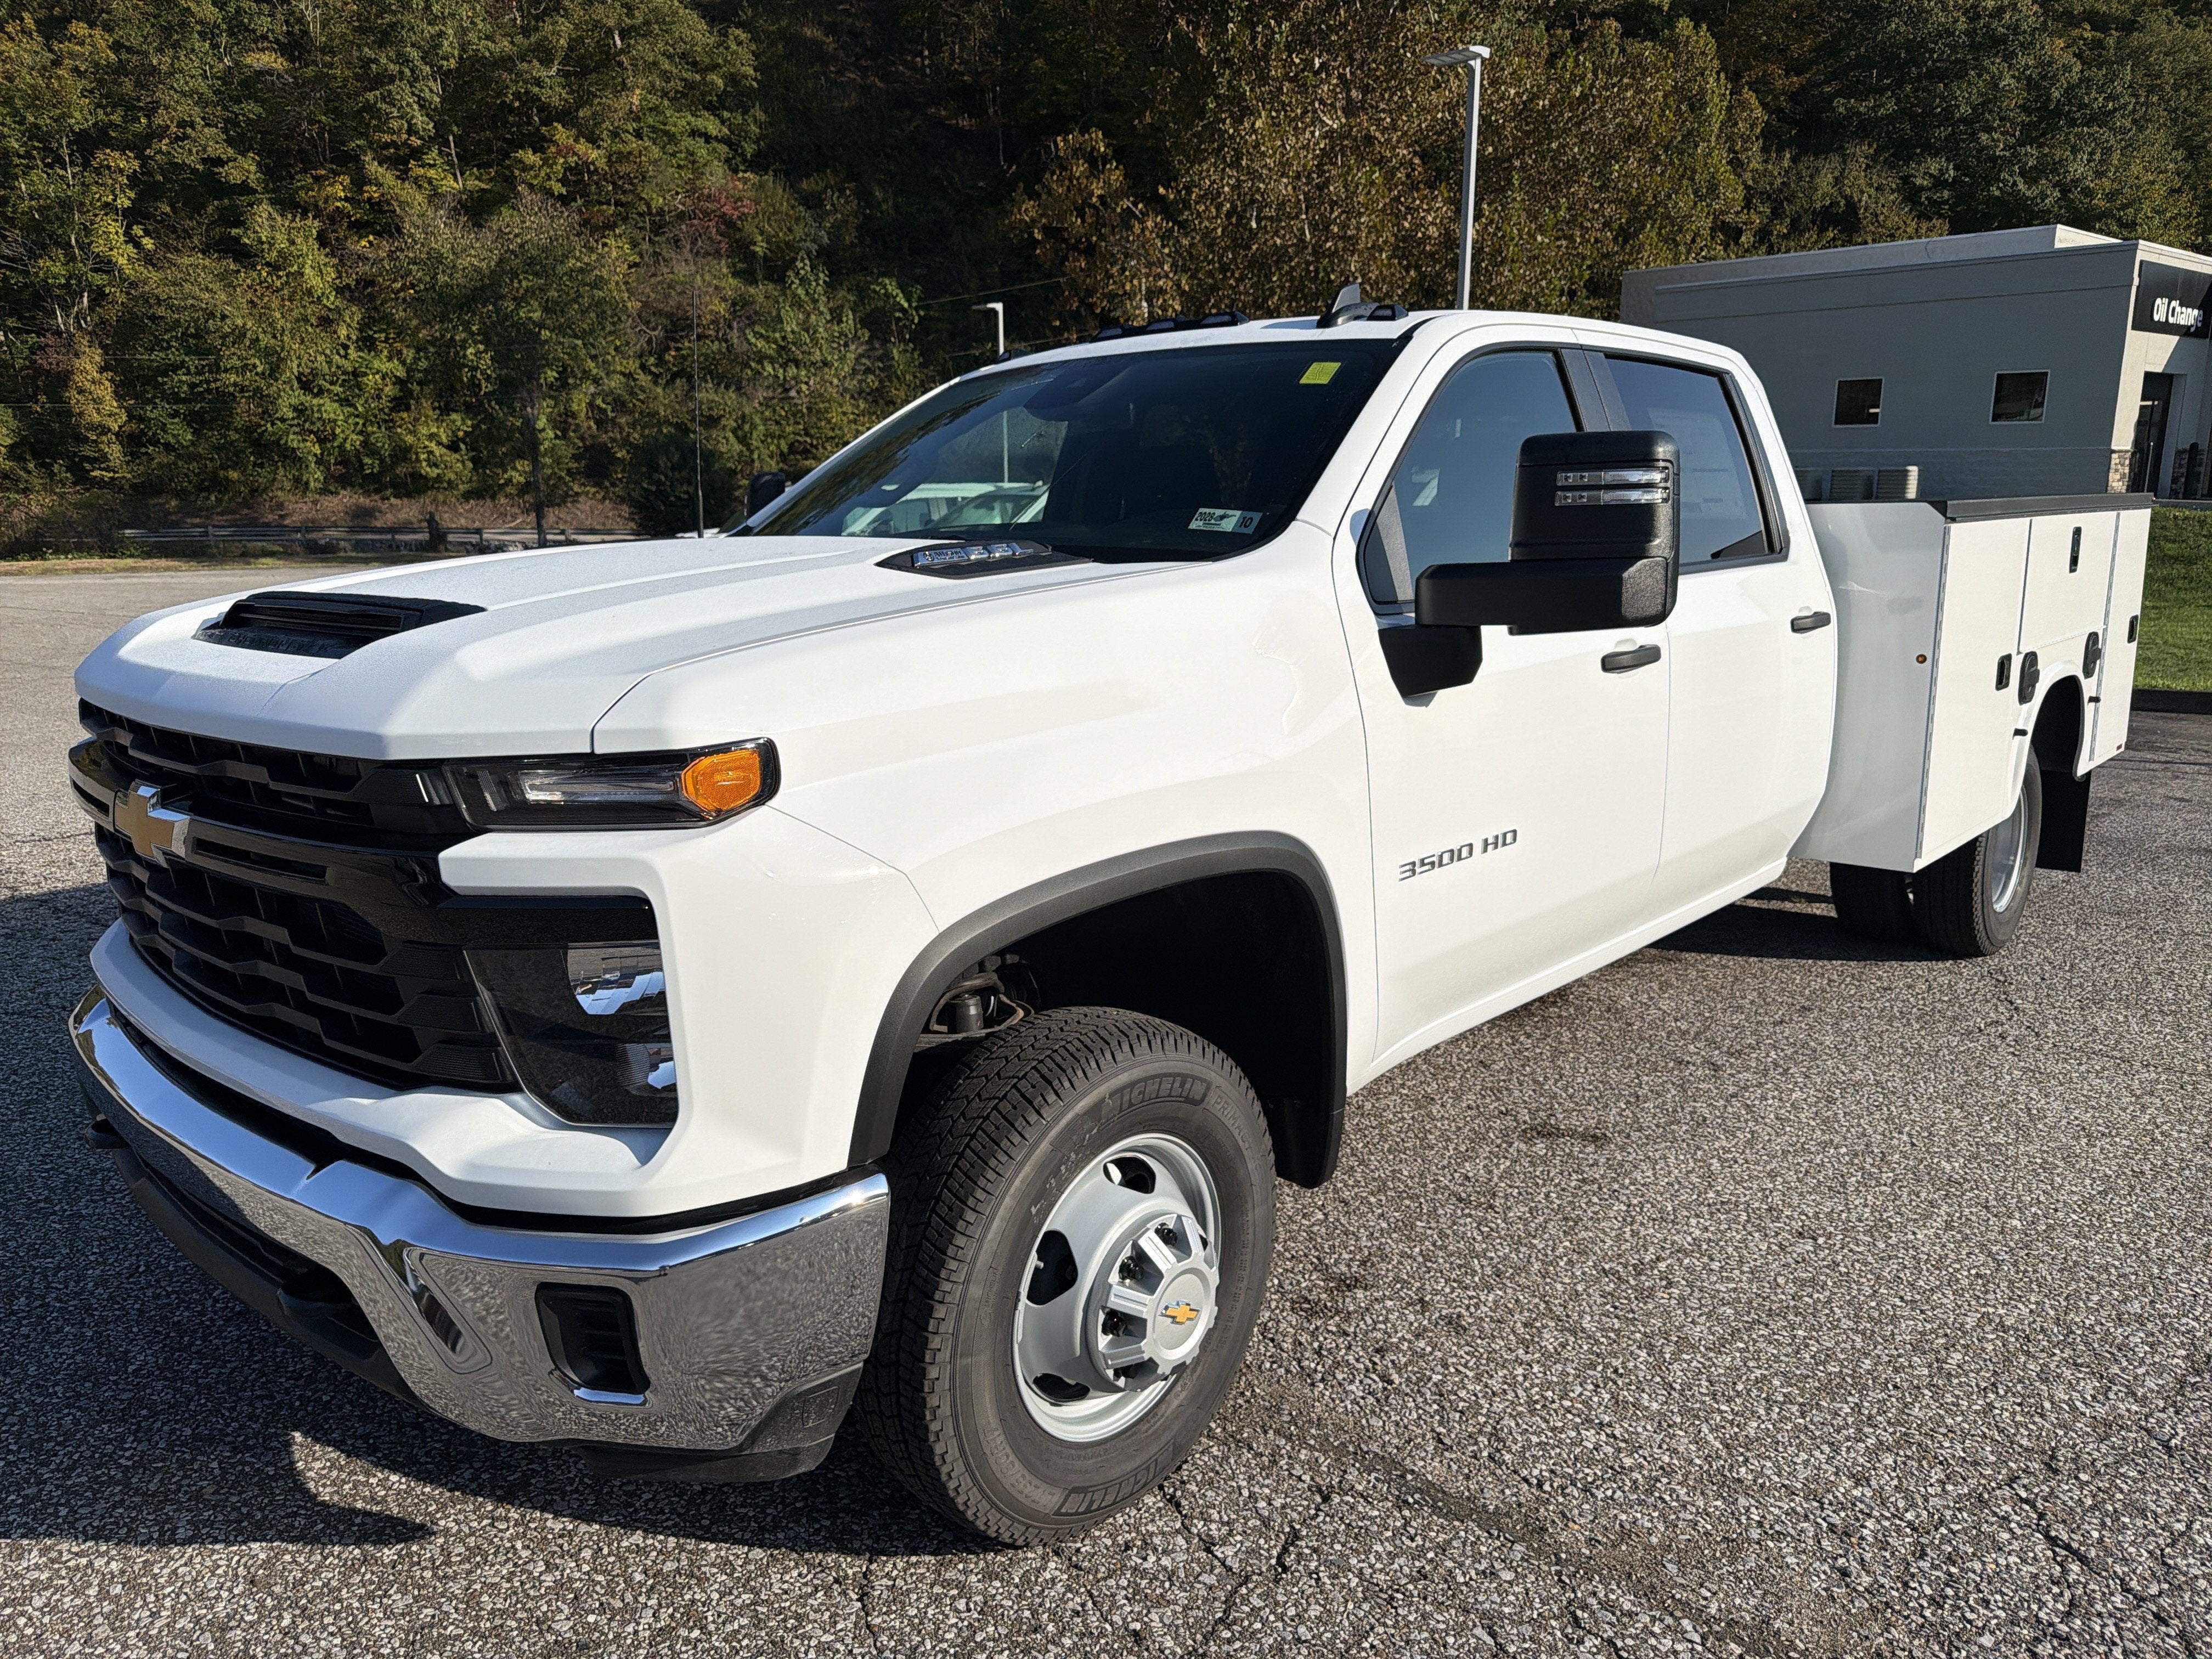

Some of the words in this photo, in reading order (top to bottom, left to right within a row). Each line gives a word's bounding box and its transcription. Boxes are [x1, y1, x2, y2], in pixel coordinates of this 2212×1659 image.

[2153, 297, 2168, 323] Oil
[2168, 300, 2203, 332] Change
[1239, 516, 1254, 528] 10
[1398, 842, 1474, 882] 3500
[1481, 828, 1517, 855] HD
[1101, 1077, 1206, 1120] MICHELIN
[1059, 1444, 1173, 1513] MICHELIN
